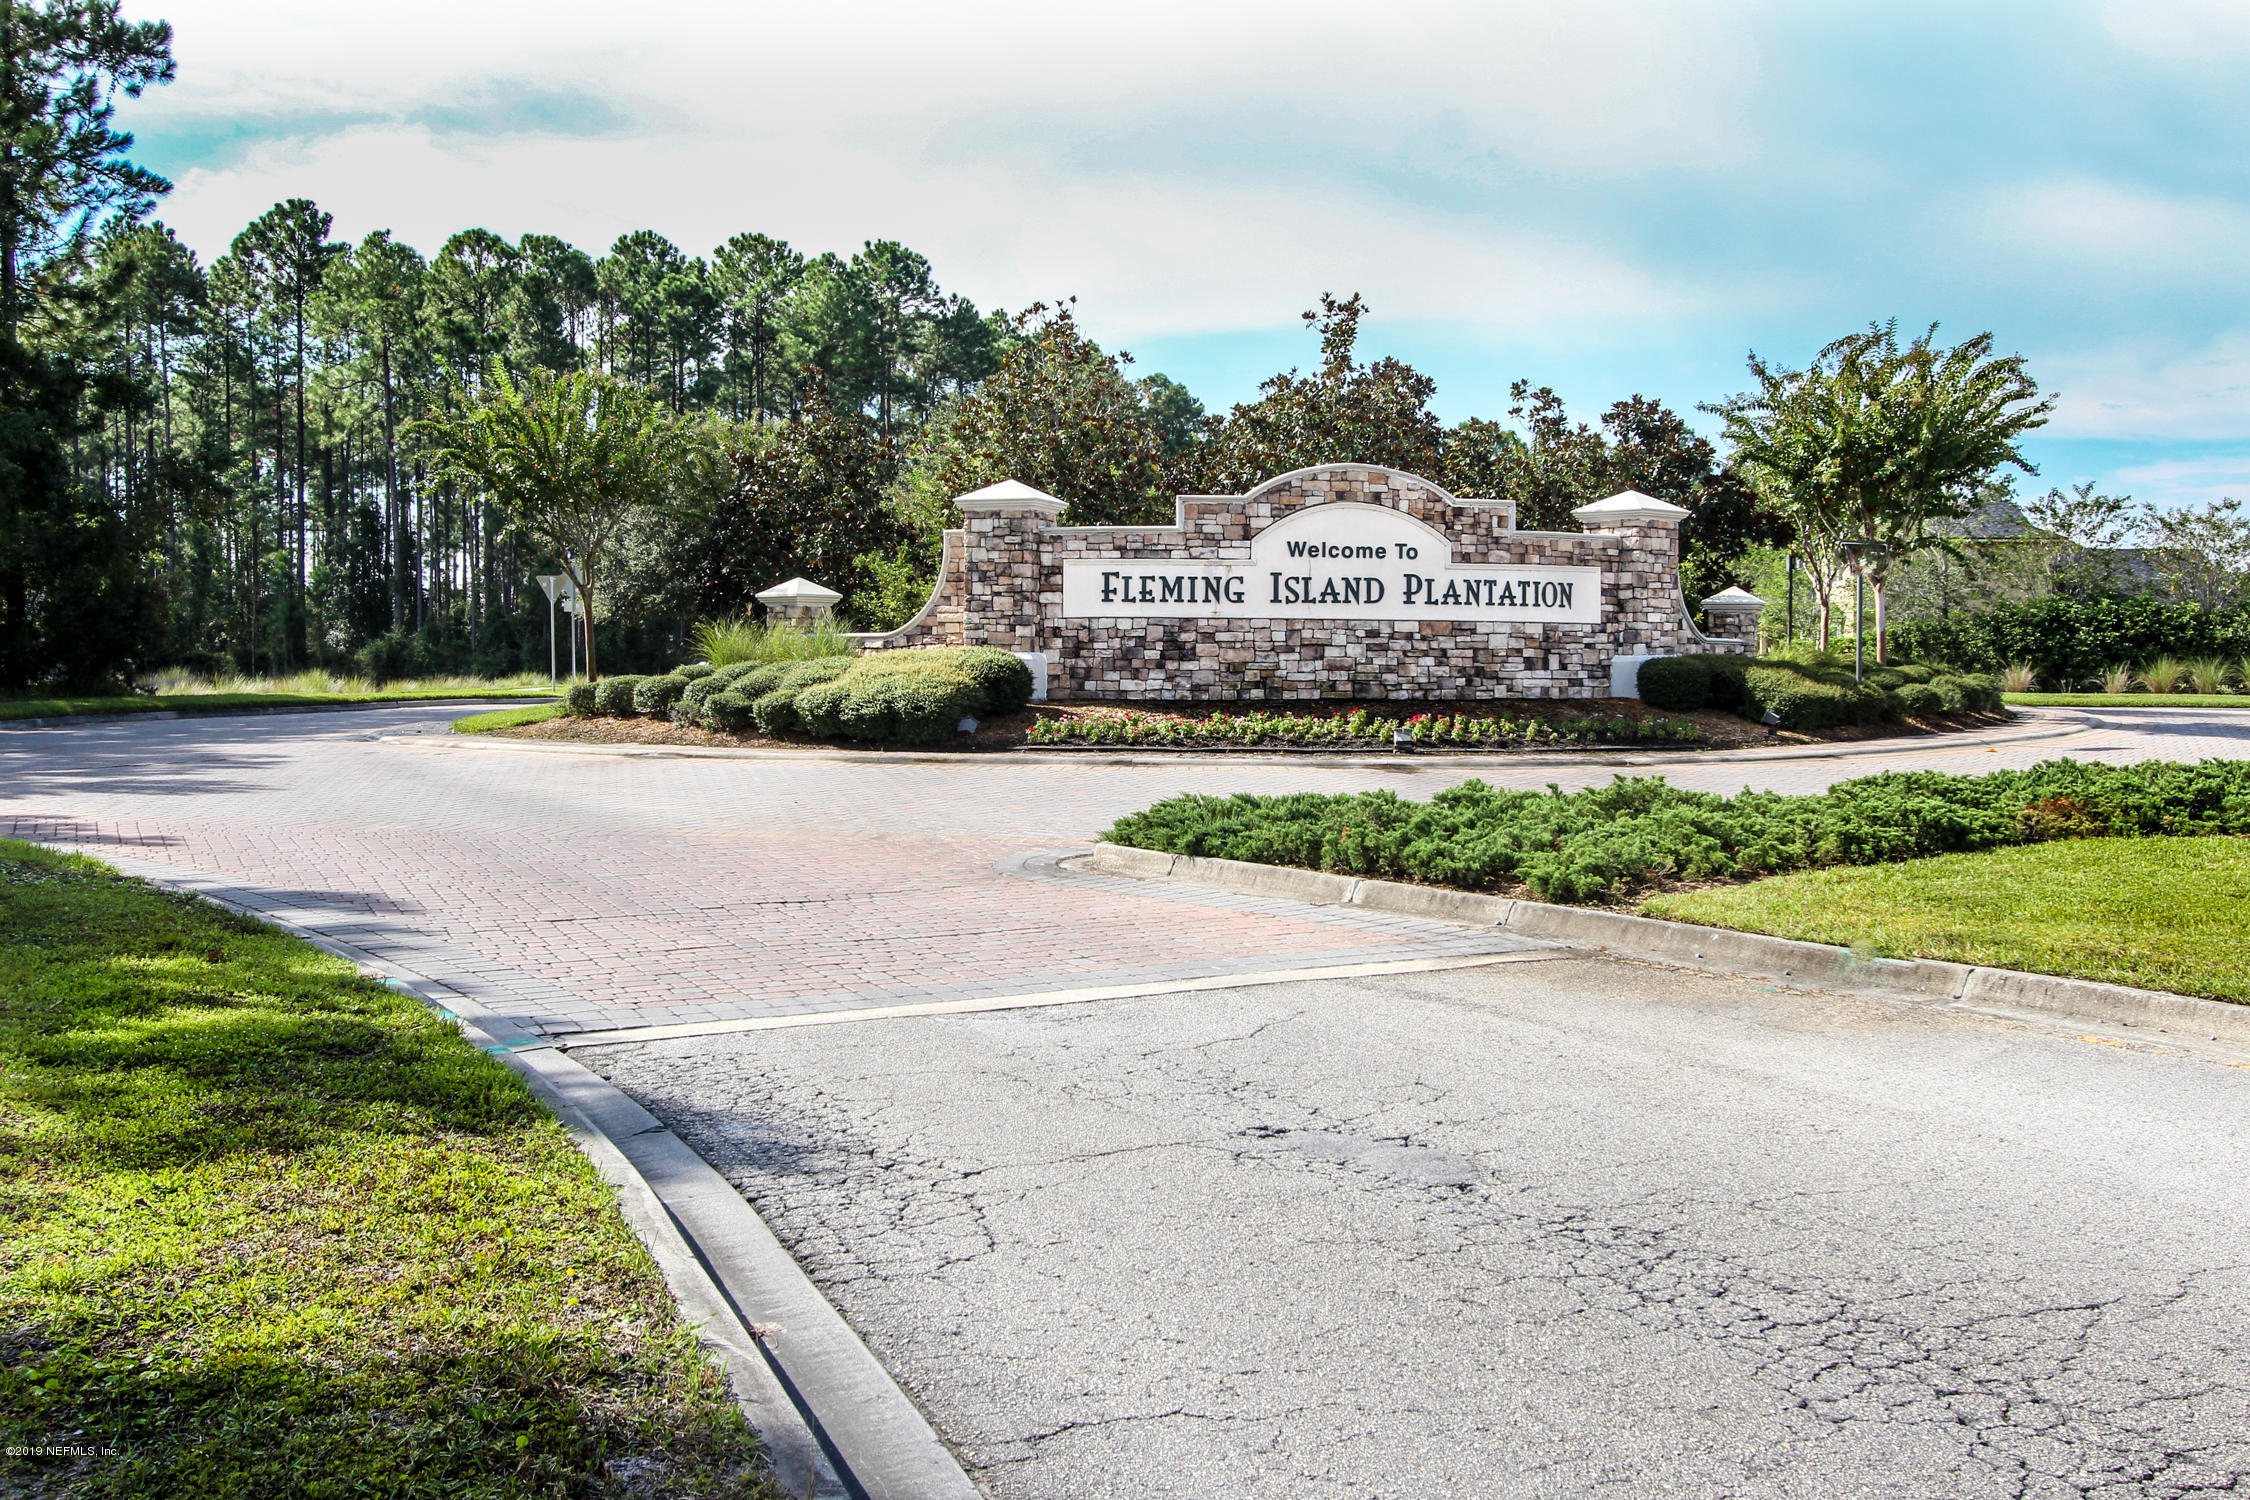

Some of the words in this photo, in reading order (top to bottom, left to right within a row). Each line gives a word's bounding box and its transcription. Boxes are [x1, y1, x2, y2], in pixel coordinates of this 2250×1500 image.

[1287, 540, 1387, 559] Welcome
[1395, 542, 1419, 560] To
[1101, 571, 1246, 604] FLEMING
[1270, 571, 1386, 605] ISLAND
[1402, 573, 1574, 609] PLANTATION
